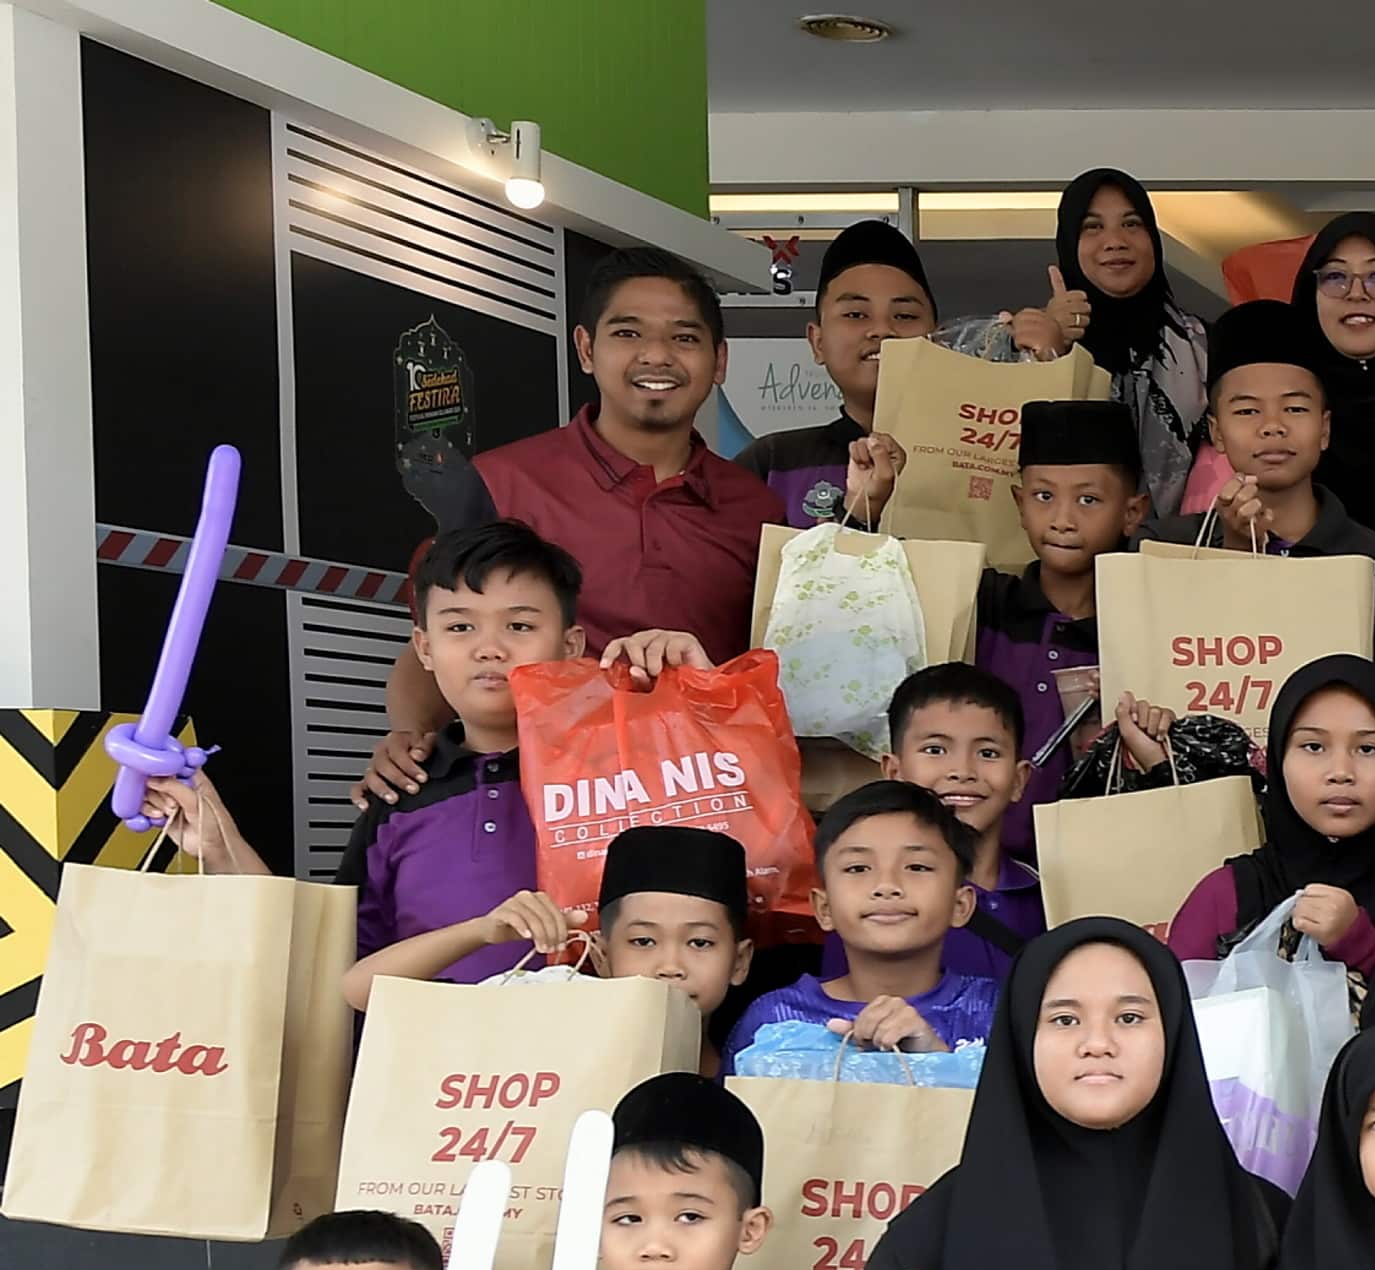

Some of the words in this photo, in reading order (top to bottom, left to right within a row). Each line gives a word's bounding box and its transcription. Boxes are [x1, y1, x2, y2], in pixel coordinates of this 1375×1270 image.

[408, 384, 461, 413] FESTIRA
[758, 362, 844, 403] Adven
[958, 404, 1021, 425] SHO
[1171, 635, 1283, 667] SHOP
[1185, 675, 1273, 715] 24/7
[543, 769, 652, 823] DINA
[660, 751, 746, 798] NIS
[59, 1022, 229, 1076] Bata
[435, 1071, 561, 1110] SHOP
[431, 1120, 538, 1163] 24/7
[358, 1181, 403, 1196] FROM
[407, 1182, 446, 1196] OUR
